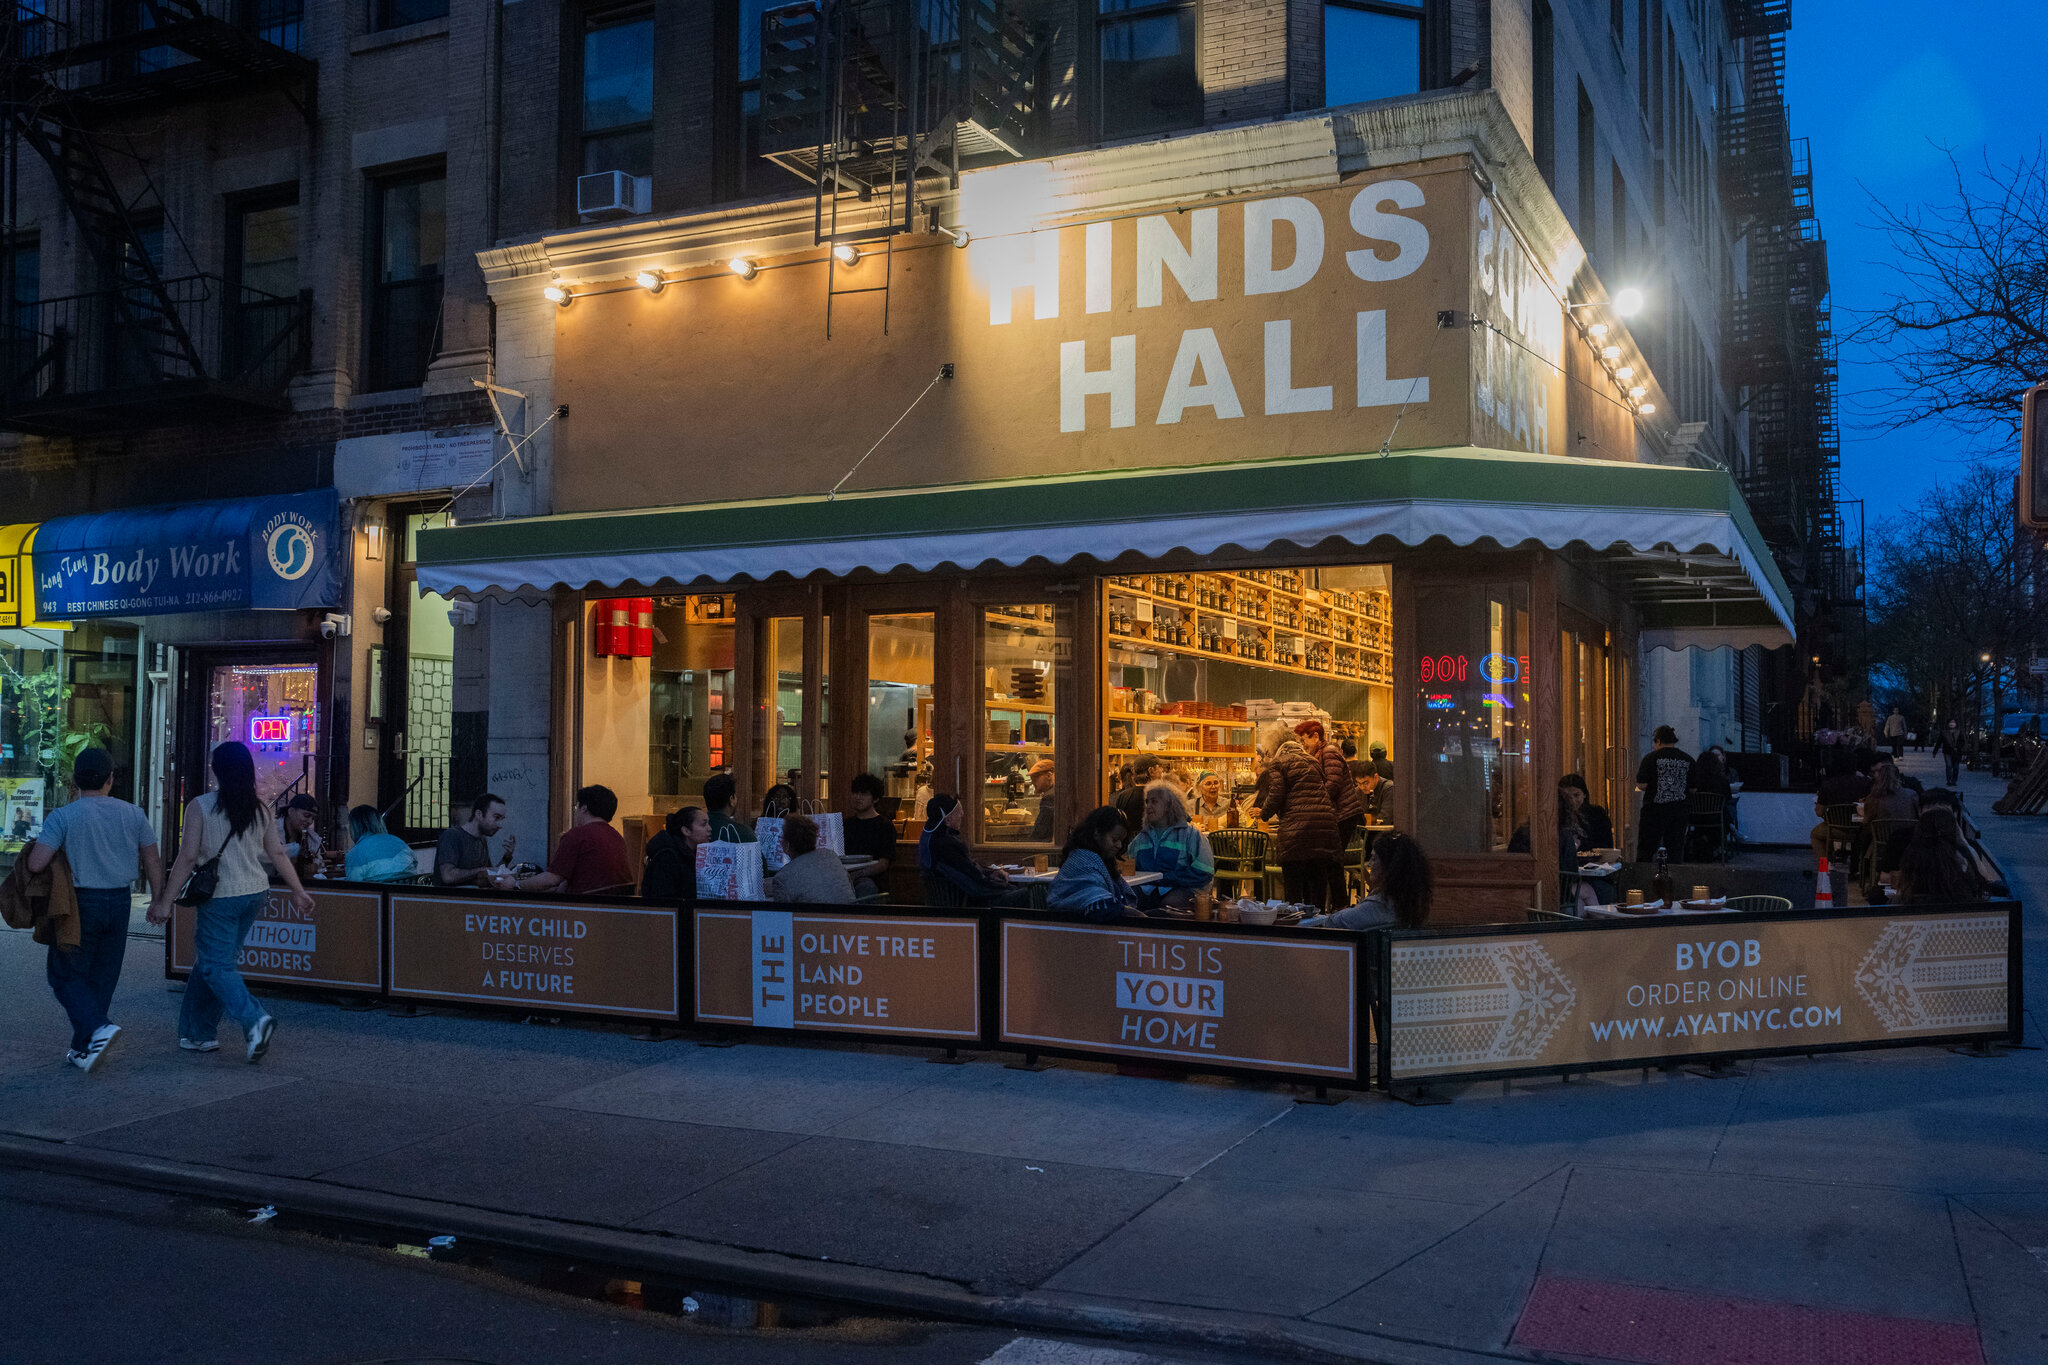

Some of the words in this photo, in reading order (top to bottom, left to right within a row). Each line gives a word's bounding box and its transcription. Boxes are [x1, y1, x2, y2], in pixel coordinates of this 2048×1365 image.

[988, 179, 1430, 325] HINDS
[1060, 310, 1430, 433] HALL
[458, 440, 491, 448] TRESPASSING
[261, 512, 288, 543] BODY
[289, 511, 319, 544] WORK
[91, 548, 160, 593] Body
[169, 539, 242, 578] Work
[43, 600, 57, 614] 943
[67, 601, 86, 613] BEST
[87, 599, 119, 612] CHINESE
[120, 597, 152, 610] QI-GONG
[154, 595, 180, 608] TUI-NA
[253, 720, 288, 740] OPEN
[251, 926, 313, 946] ITHOUT
[465, 914, 524, 935] EVERY
[528, 918, 588, 940] CHILD
[482, 943, 574, 967] DESERVES
[800, 933, 869, 956] OLIVE
[875, 936, 935, 958] TREE
[1118, 940, 1186, 972] THIS
[1199, 947, 1222, 974] IS
[1676, 939, 1762, 971] BYOB
[237, 949, 312, 972] BORDERS
[762, 934, 785, 1008] THE
[800, 964, 863, 986] LAND
[482, 970, 496, 988] A
[500, 971, 574, 994] FUTURE
[1124, 978, 1216, 1010] YOUR
[1627, 979, 1711, 1008] ORDER
[1718, 975, 1808, 1003] ONLINE
[800, 994, 889, 1018] PEOPLE
[1121, 1014, 1218, 1049] HOME
[1590, 1004, 1842, 1043] WWW.AYATNYC.COM
